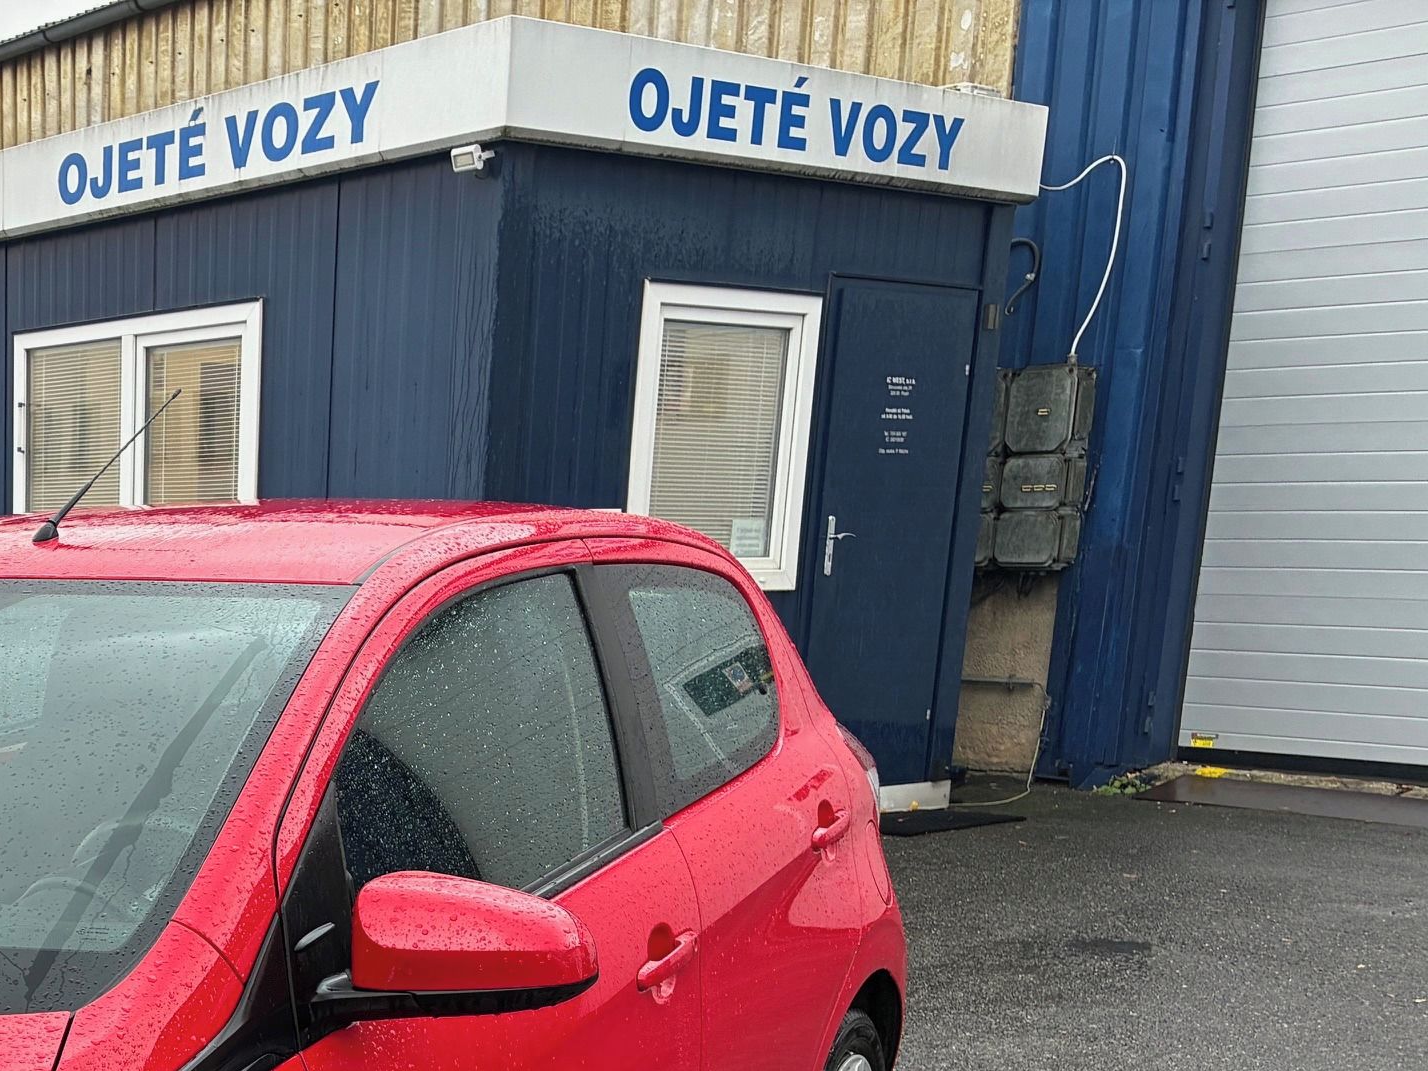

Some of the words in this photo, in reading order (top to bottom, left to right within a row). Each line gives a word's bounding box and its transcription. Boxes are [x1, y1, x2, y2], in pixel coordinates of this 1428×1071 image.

[58, 107, 207, 205] OJETÉ
[225, 80, 380, 169] VOZY
[629, 67, 812, 152] OJETÉ
[829, 98, 964, 171] VOZY
